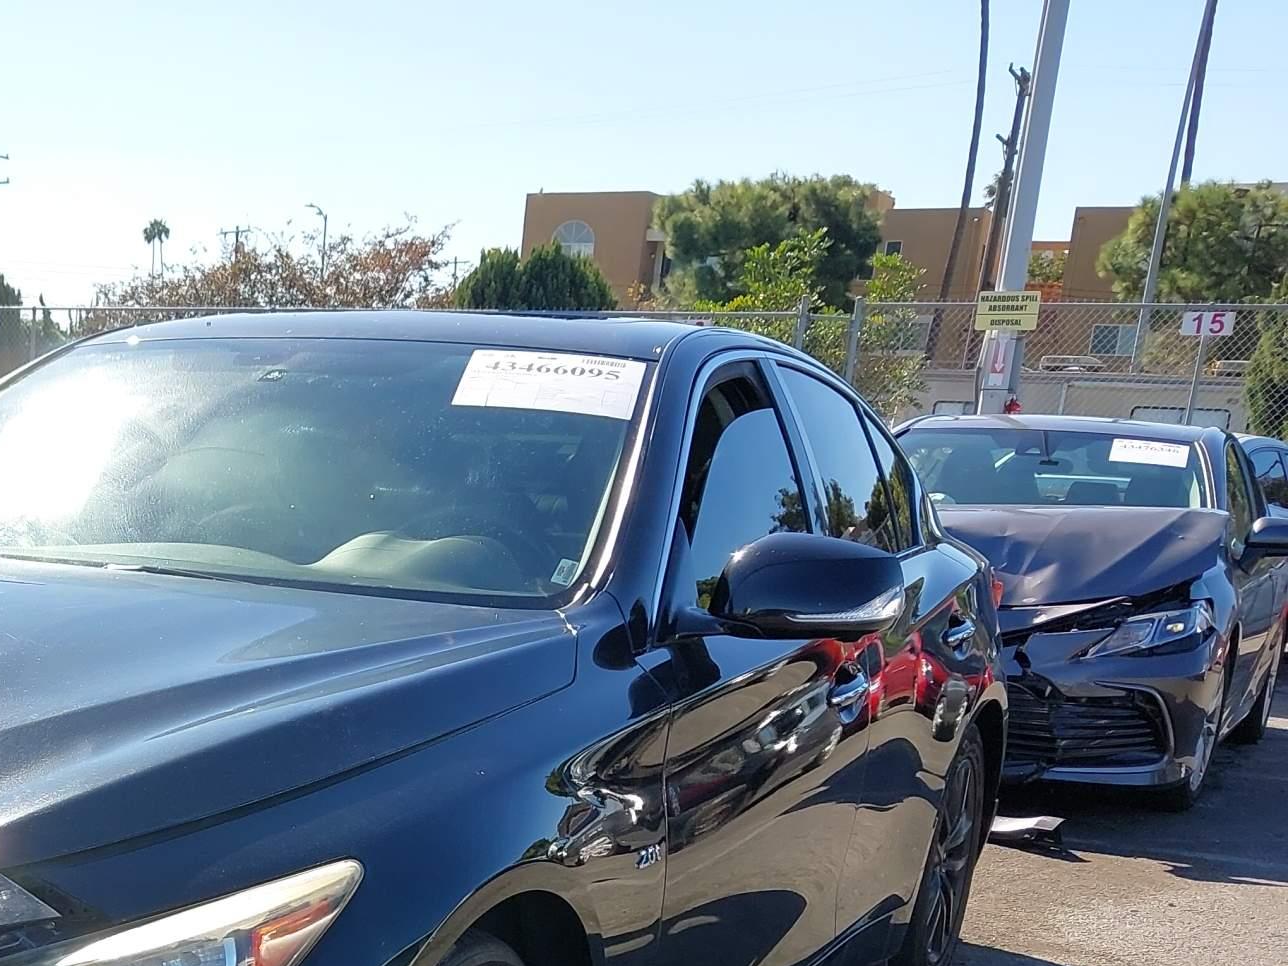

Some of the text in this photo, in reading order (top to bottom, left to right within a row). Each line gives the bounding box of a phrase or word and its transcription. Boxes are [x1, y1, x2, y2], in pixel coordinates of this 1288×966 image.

[980, 294, 1038, 303] HAZARDOUS SPILL
[1192, 312, 1226, 335] 15
[485, 360, 621, 381] 43466095
